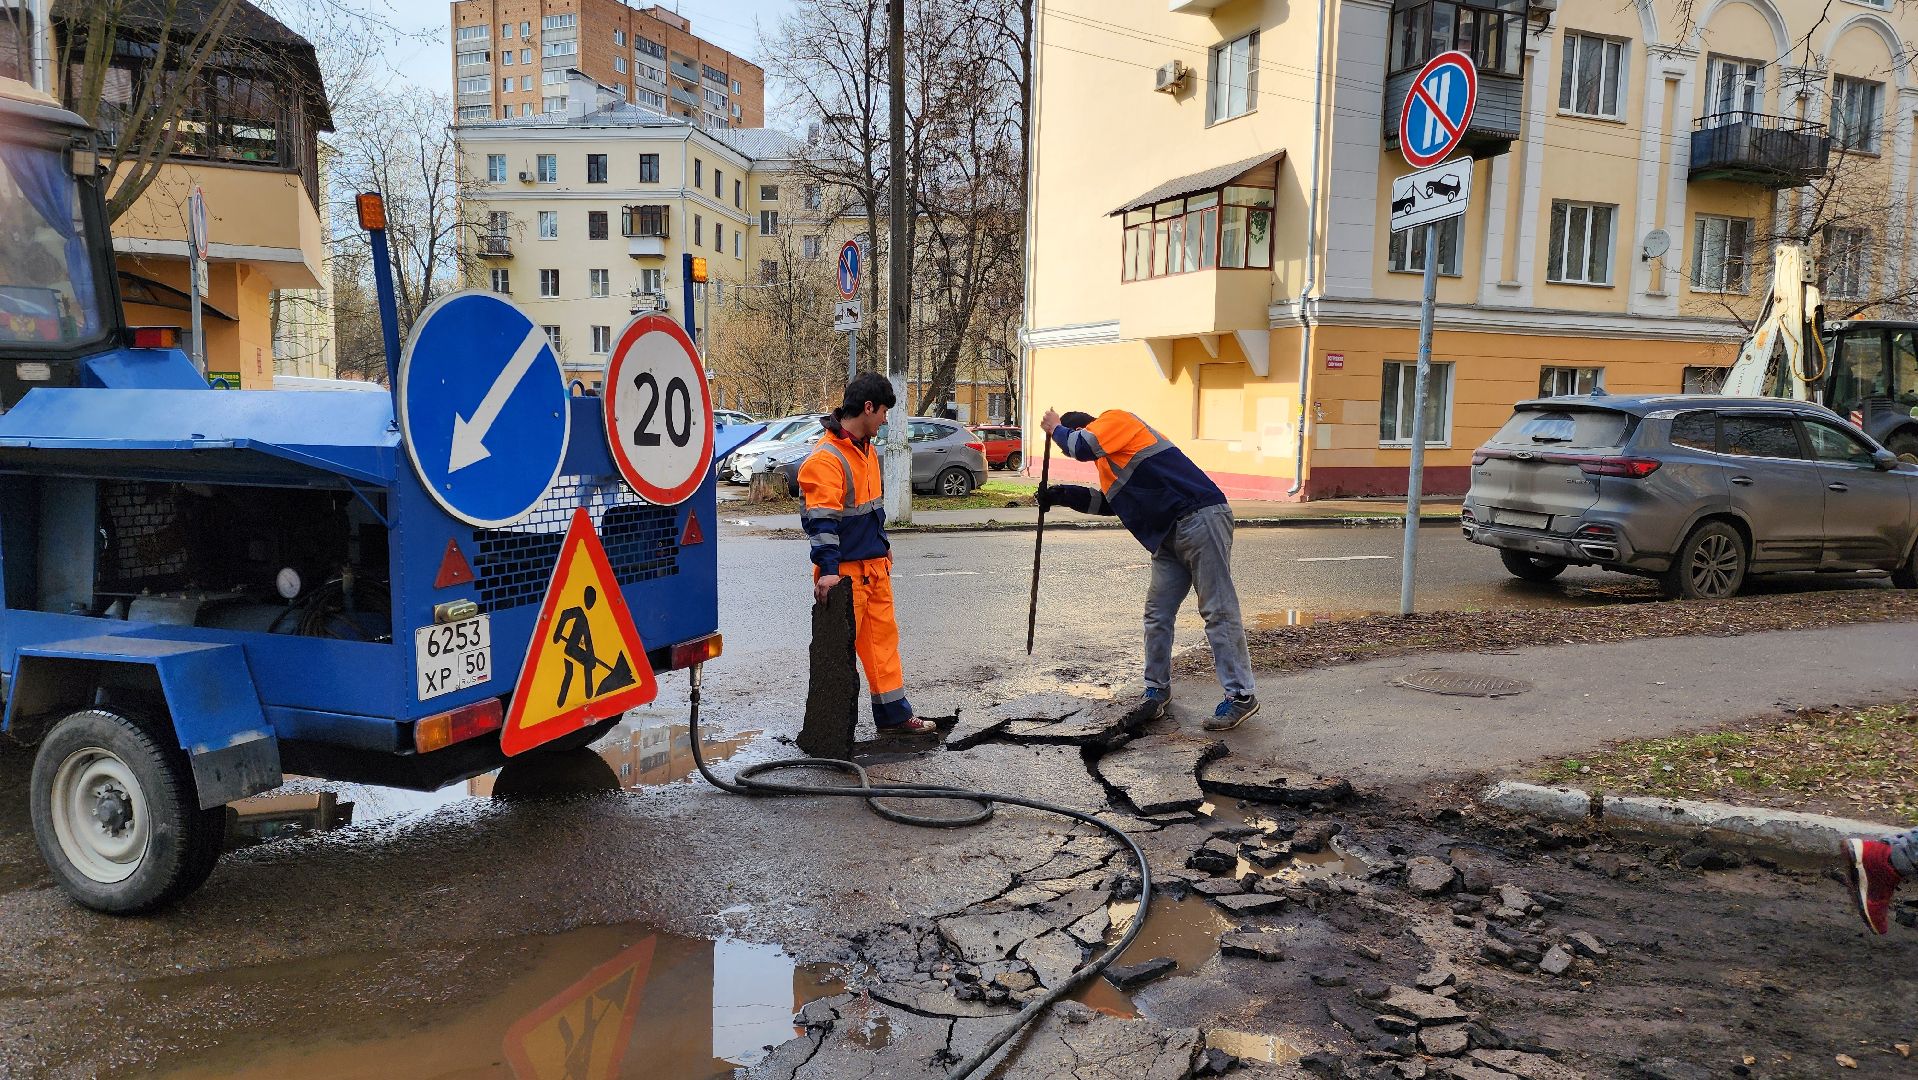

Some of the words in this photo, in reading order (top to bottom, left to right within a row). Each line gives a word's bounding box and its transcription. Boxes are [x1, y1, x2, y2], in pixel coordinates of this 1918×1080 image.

[634, 371, 692, 448] 20
[428, 620, 481, 657] 6253
[465, 651, 486, 675] 50
[461, 675, 477, 685] RUS
